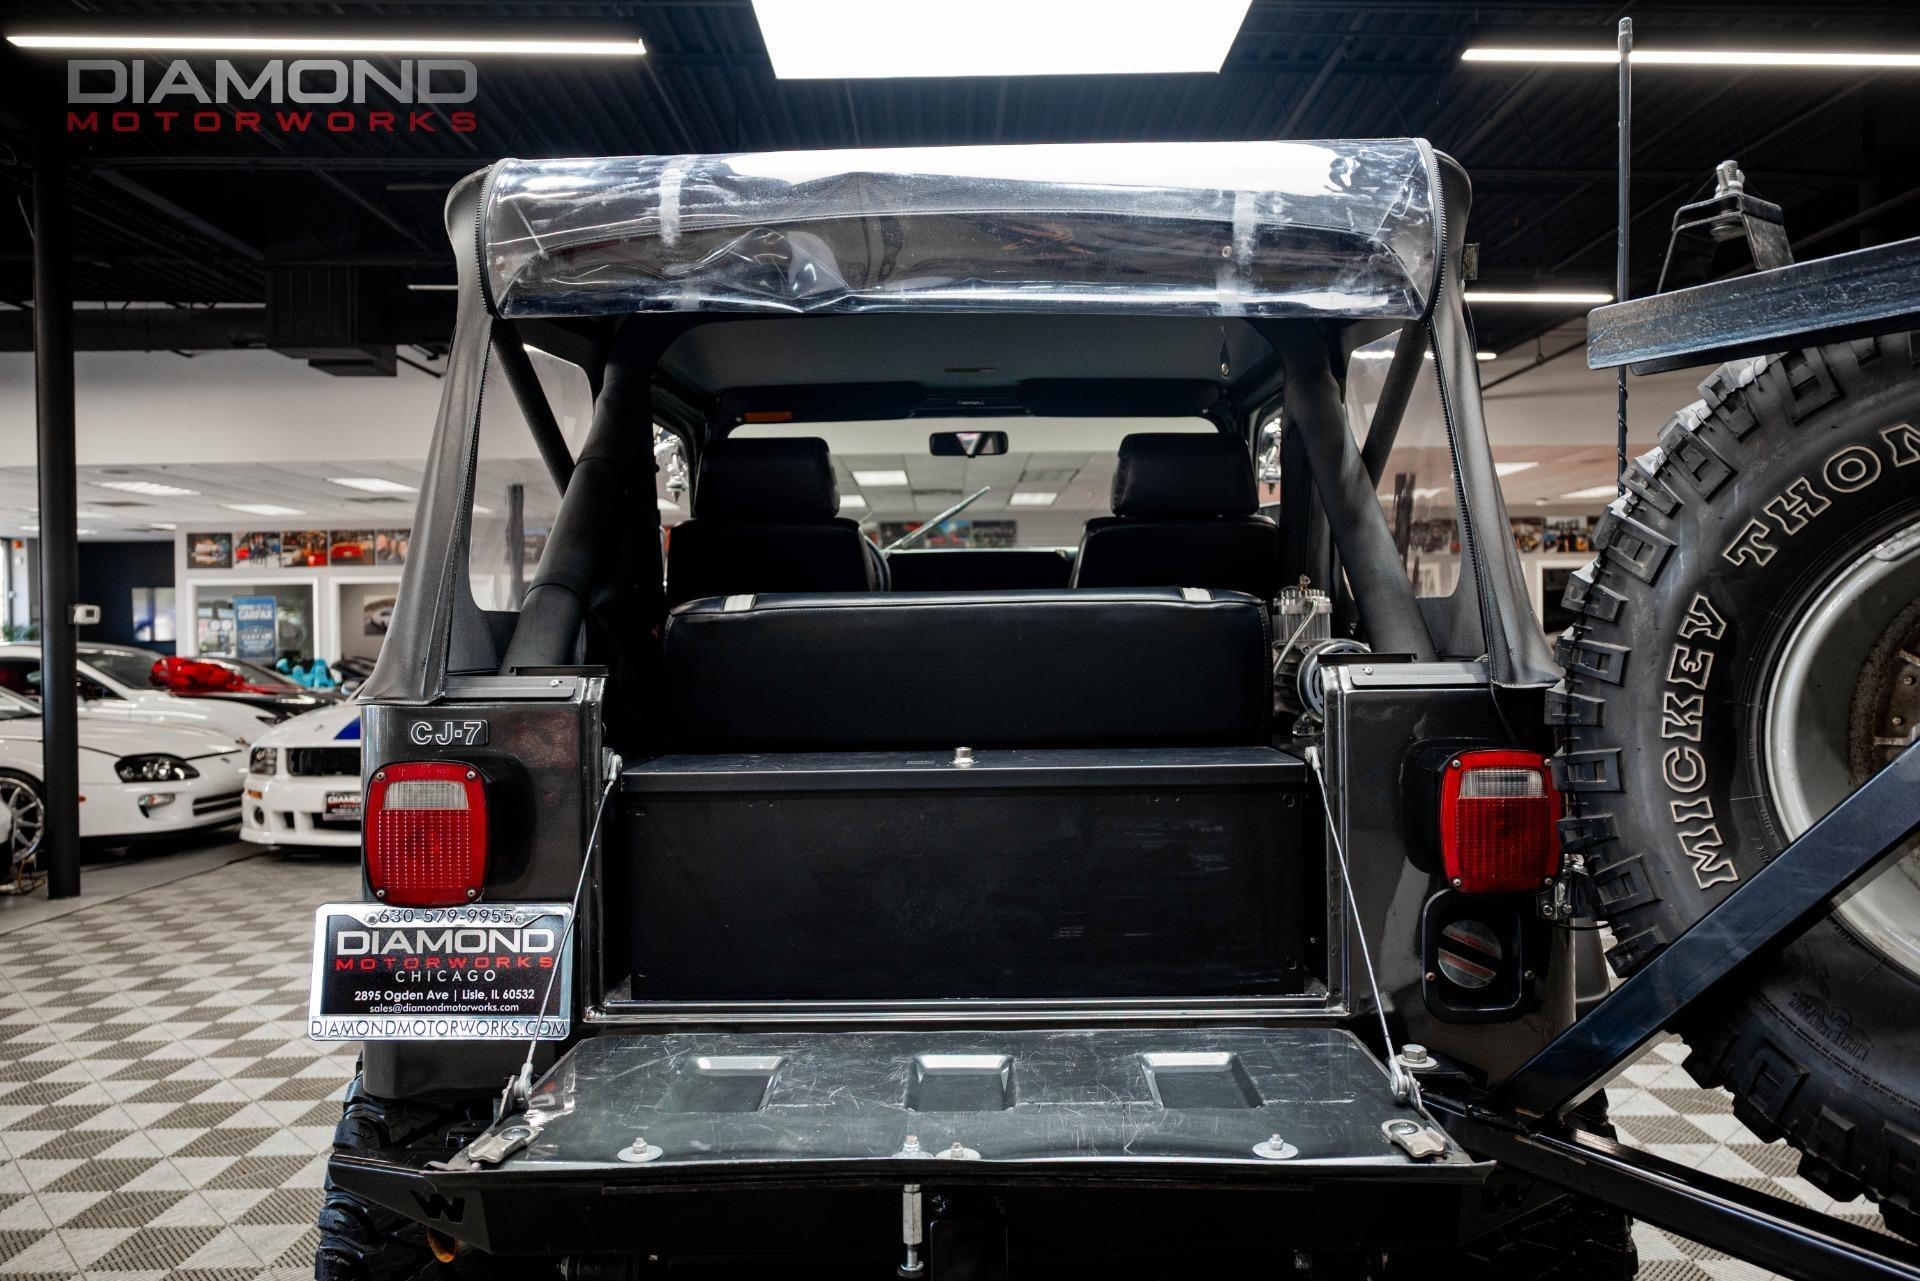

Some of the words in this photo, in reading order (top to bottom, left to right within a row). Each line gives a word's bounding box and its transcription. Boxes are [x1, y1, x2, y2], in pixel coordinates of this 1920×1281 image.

[410, 721, 482, 746] CJ-7
[1662, 592, 1740, 890] MICKEY
[379, 908, 514, 924] 630-579-9955
[336, 928, 555, 956] DIAMOND
[335, 955, 555, 971] MOTORWORKS
[395, 969, 497, 983] CHICAGO
[354, 990, 382, 1001] 2895
[384, 989, 424, 1003] Ogden
[426, 989, 449, 1000] Ave
[462, 989, 488, 1001] Lisle,
[491, 989, 500, 1000] IL
[502, 988, 535, 1000] 60532
[369, 1002, 520, 1014] sales@diamondmotorworks.com
[310, 1020, 567, 1036] DIAMONDMOTORWORKS.COM
